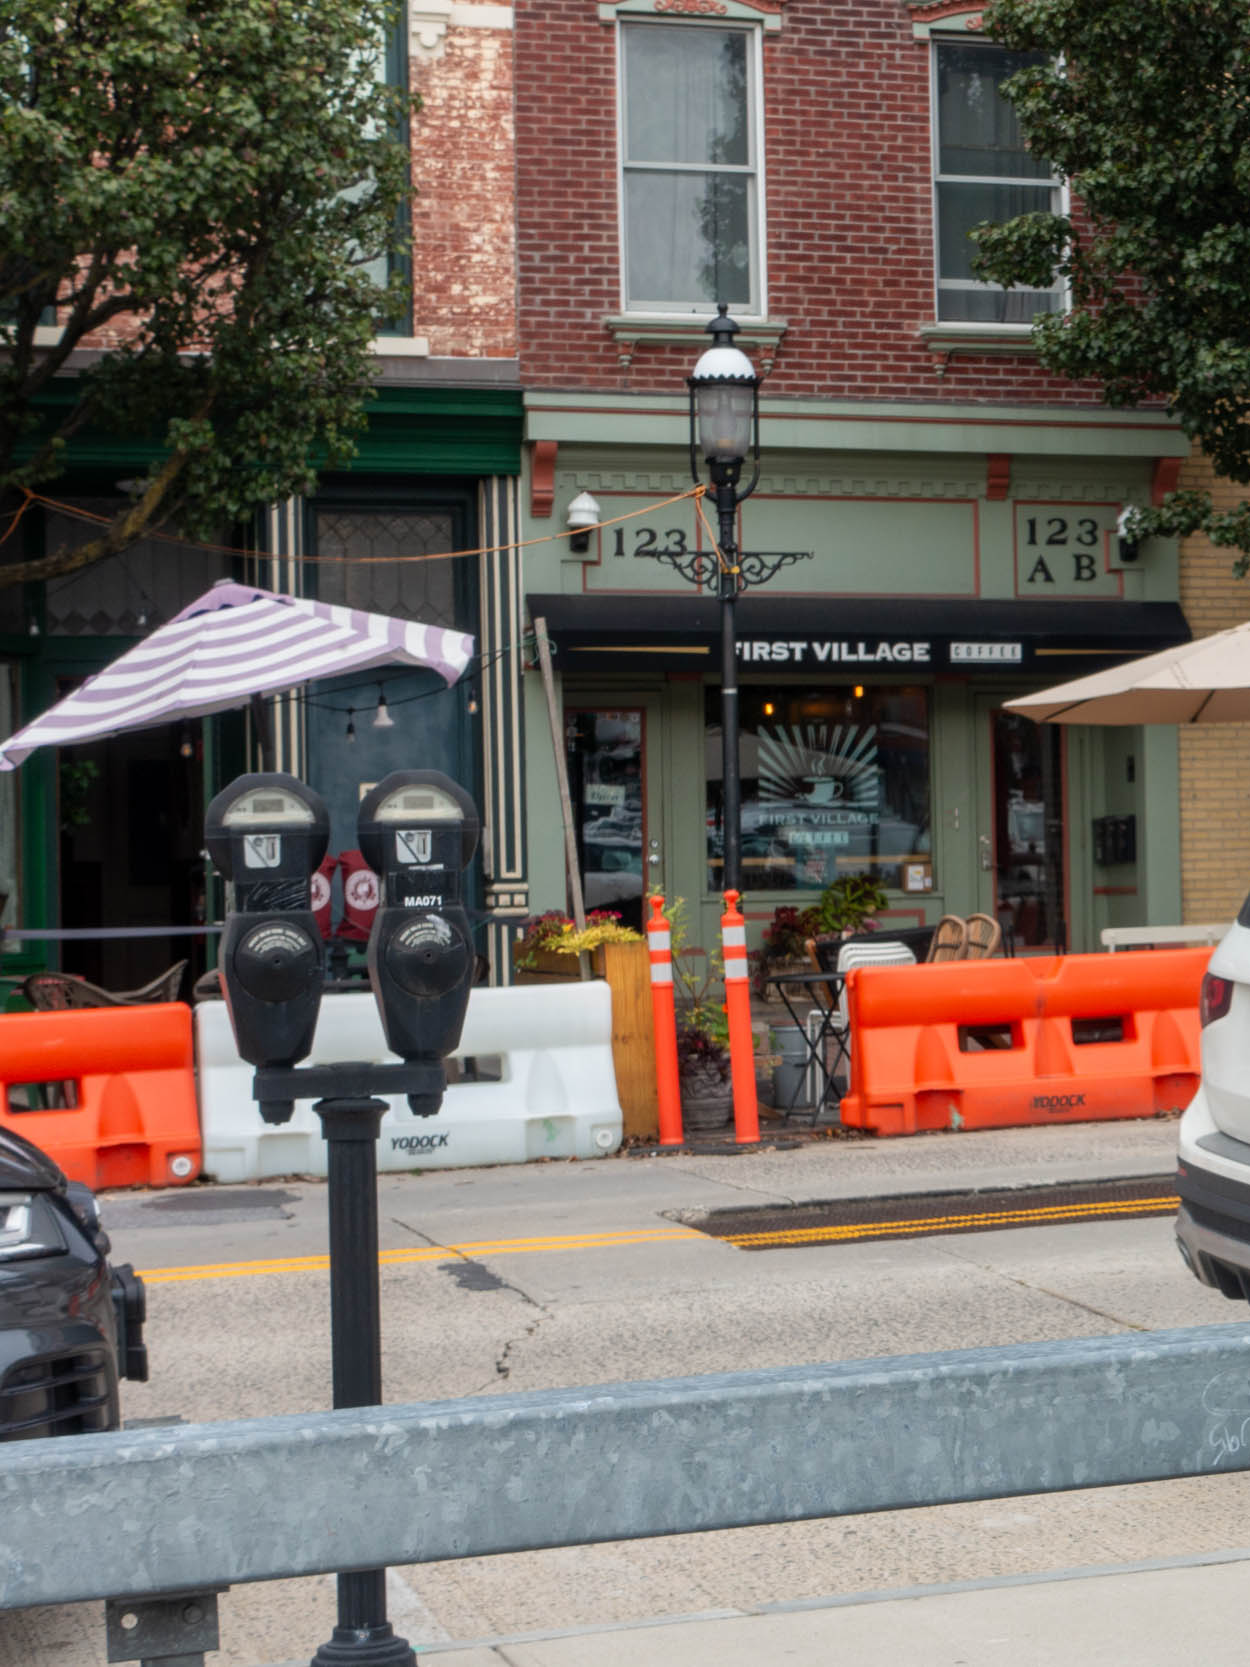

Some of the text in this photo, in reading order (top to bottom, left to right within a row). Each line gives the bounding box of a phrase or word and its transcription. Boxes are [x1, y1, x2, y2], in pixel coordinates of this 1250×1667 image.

[612, 526, 688, 558] 123
[1026, 517, 1099, 547] 123
[1027, 553, 1097, 583] A B
[811, 640, 931, 662] VILLAGE
[952, 644, 1020, 659] COFFEE
[810, 812, 880, 825] VILLAGE
[404, 895, 443, 908] MA071
[391, 1131, 450, 1151] YODOCK
